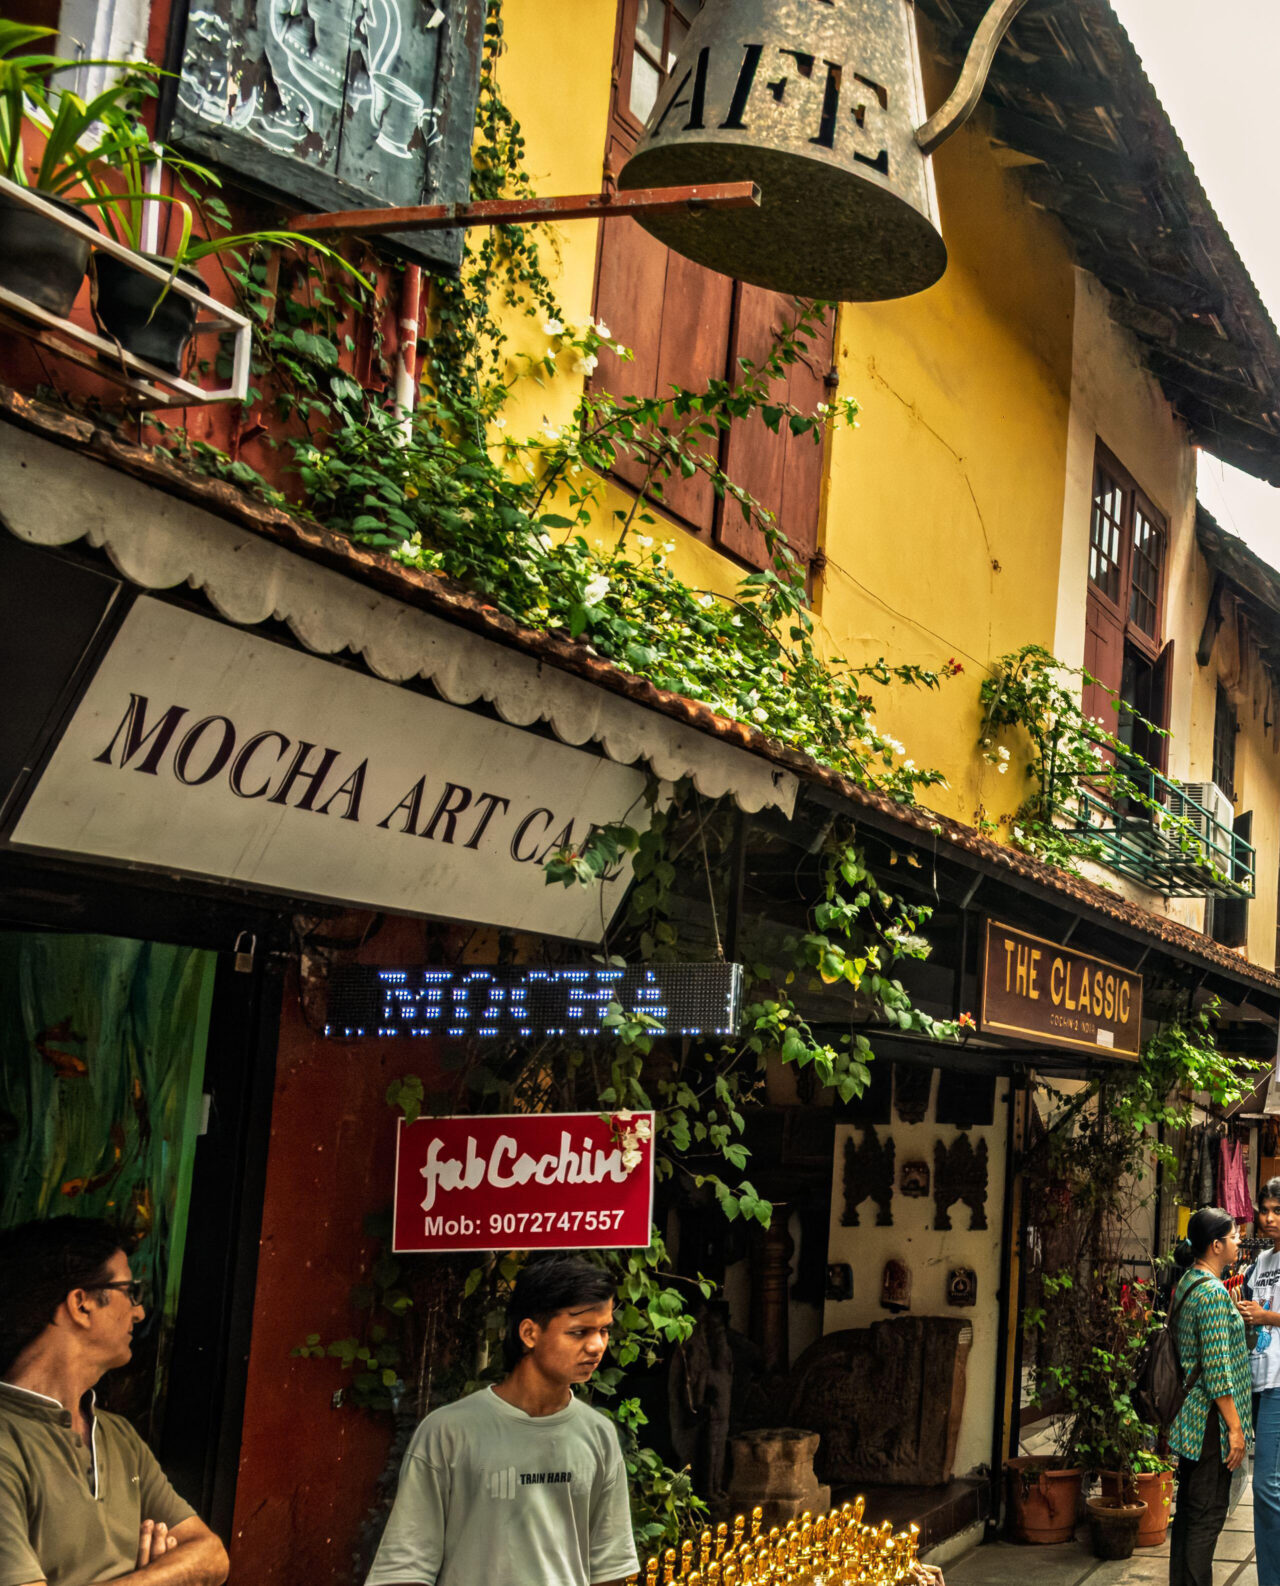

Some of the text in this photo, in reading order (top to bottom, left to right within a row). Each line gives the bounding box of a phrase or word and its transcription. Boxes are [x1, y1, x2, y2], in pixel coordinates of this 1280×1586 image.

[650, 43, 889, 177] AFE
[94, 692, 371, 823] MOCHA
[378, 774, 510, 851] ART
[1004, 938, 1131, 1024] THE CLASSIC
[424, 1210, 625, 1236] Mob: 9072747557
[520, 1472, 572, 1485] TRAIN HARD
